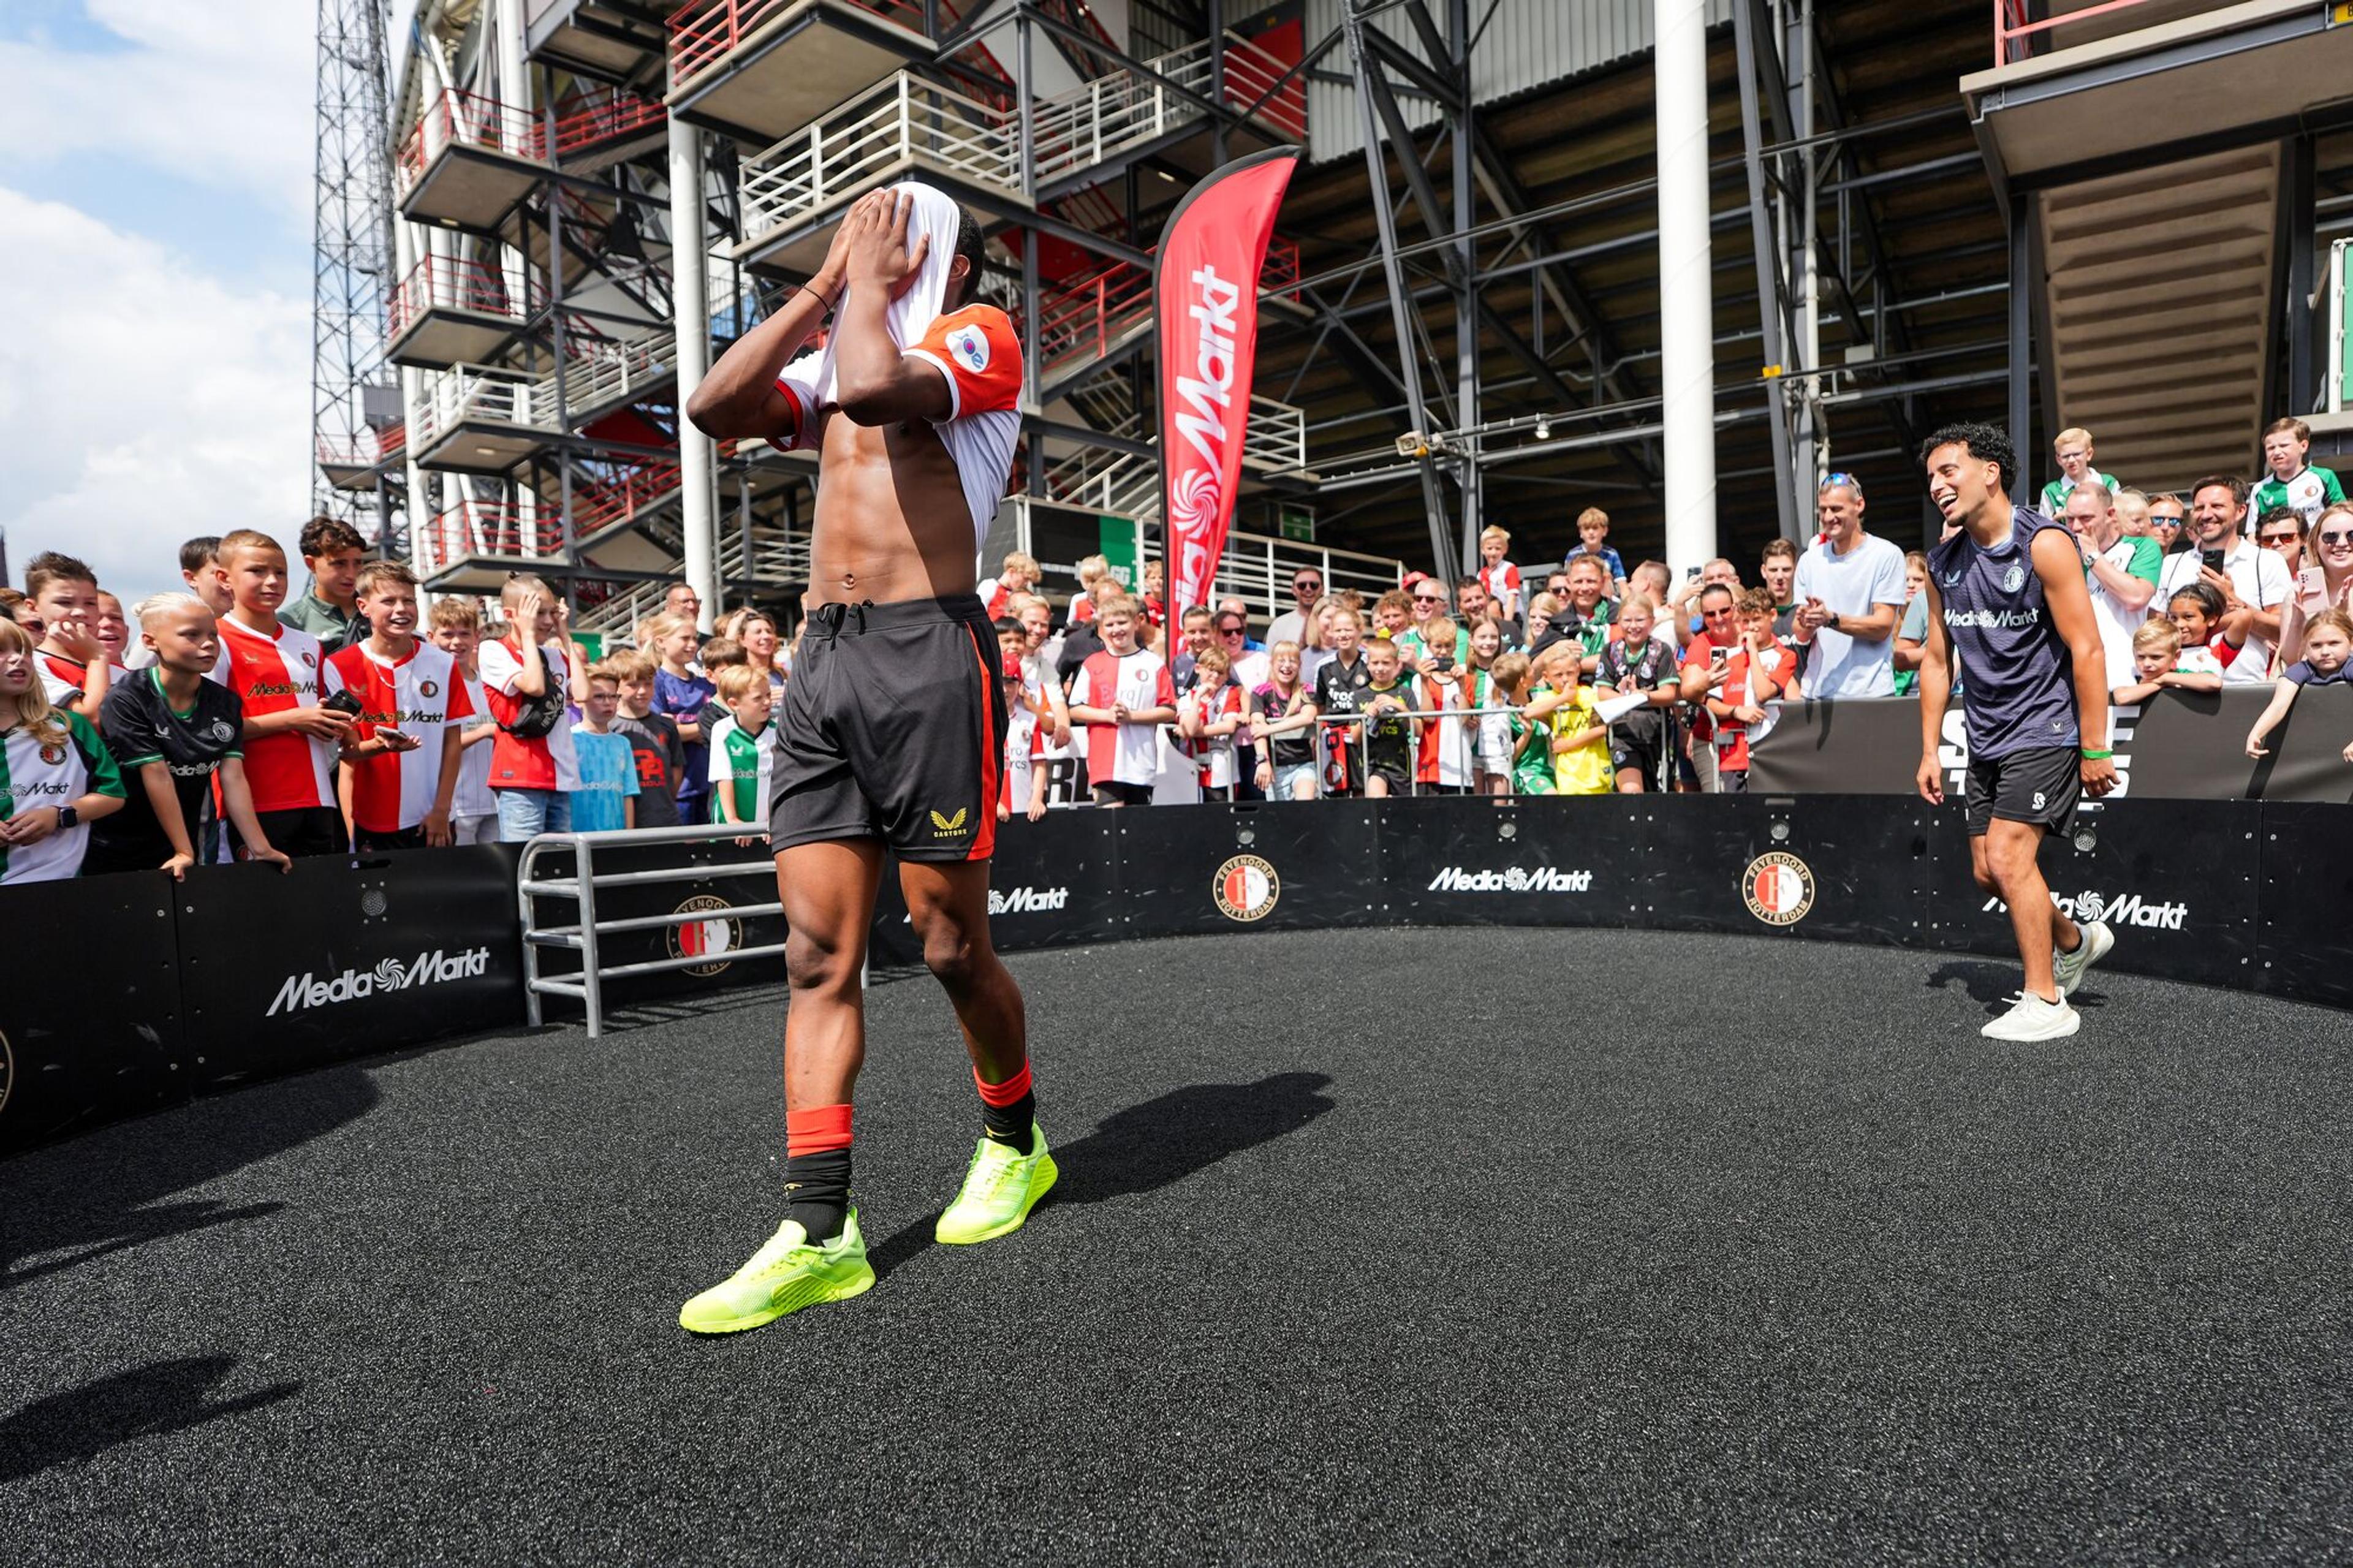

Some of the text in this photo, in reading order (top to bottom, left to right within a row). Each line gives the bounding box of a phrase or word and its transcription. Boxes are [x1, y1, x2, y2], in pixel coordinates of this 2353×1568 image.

[1169, 264, 1239, 486] Markt
[1992, 607, 2039, 627] Markt
[246, 681, 289, 697] Media
[405, 709, 443, 724] Markt
[166, 761, 196, 776] edia
[1218, 857, 1273, 881] FEYENOORD
[1427, 866, 1593, 892] Media Markt
[1748, 855, 1808, 881] FEYENOORD
[999, 887, 1069, 914] Markt
[1219, 895, 1274, 919] ROTTERDAM
[1748, 896, 1808, 923] ROTTERDAM
[2098, 893, 2188, 930] Markt
[265, 946, 490, 1017] Media Markt
